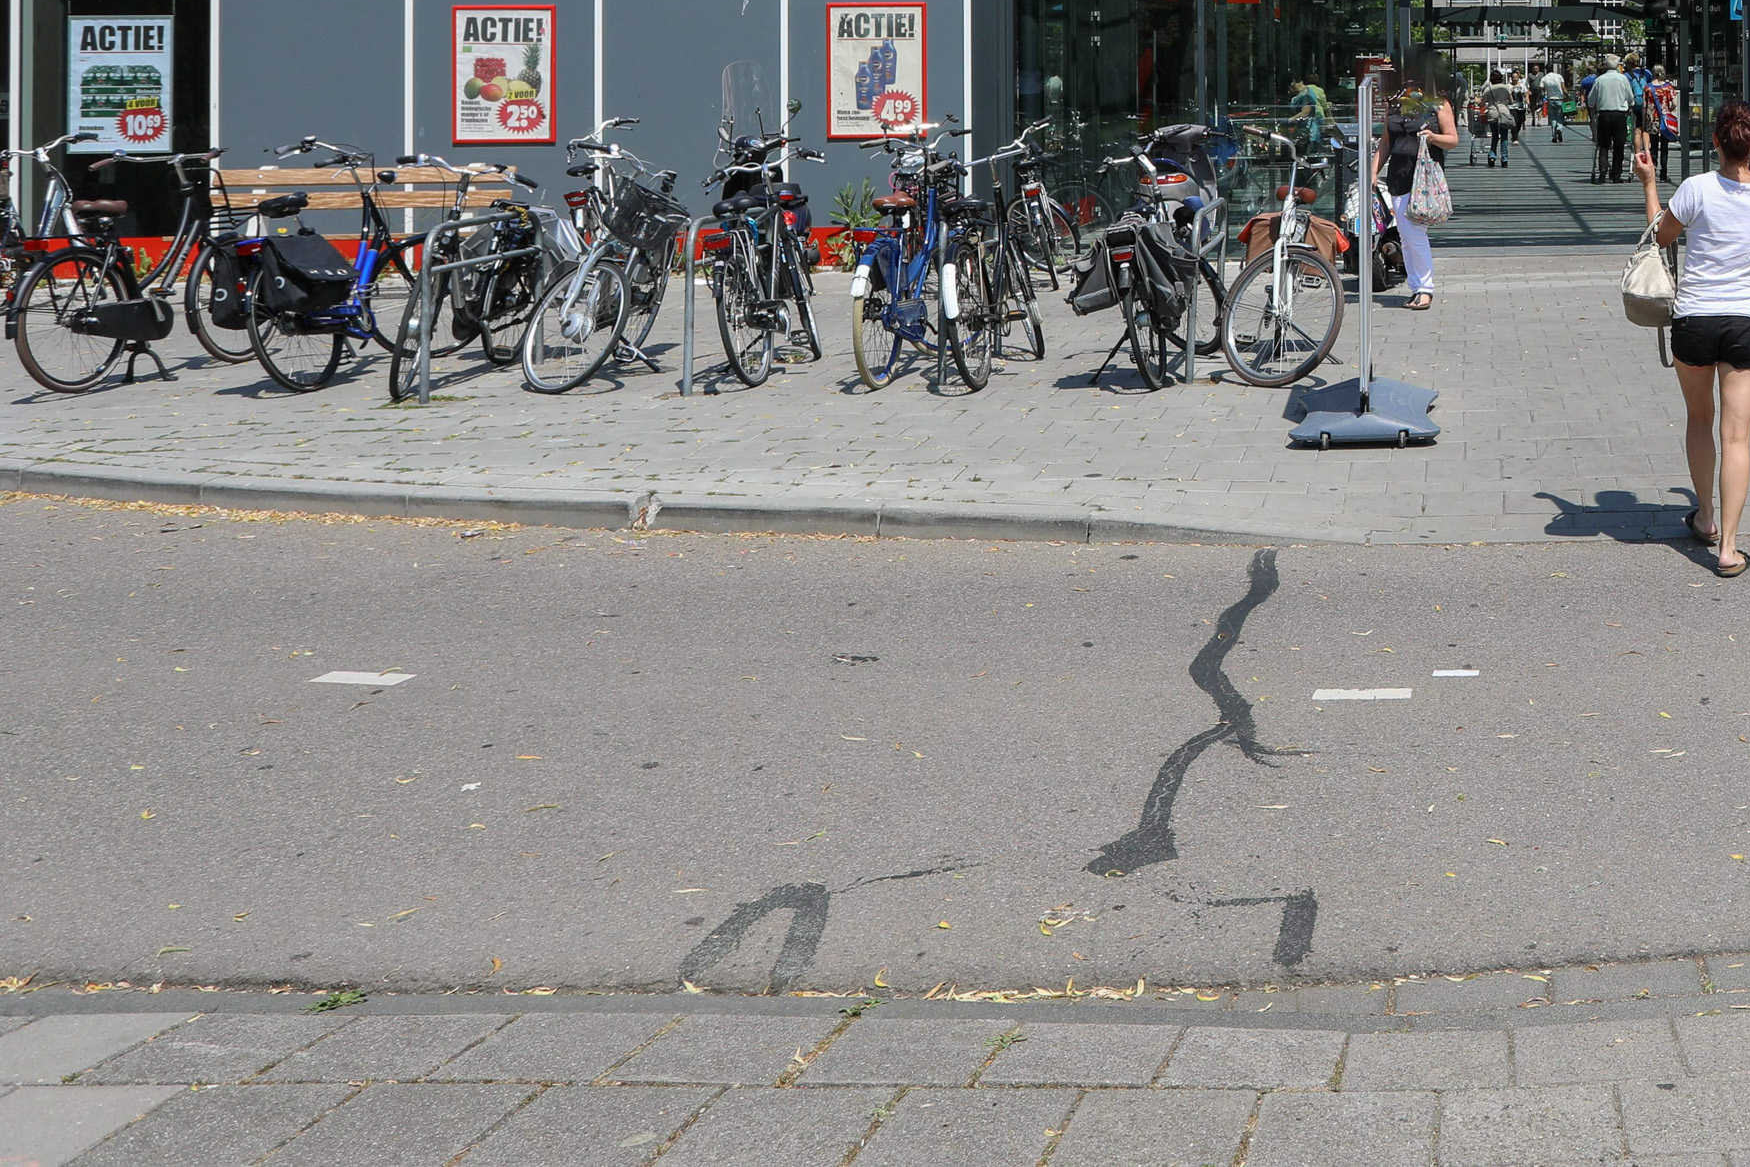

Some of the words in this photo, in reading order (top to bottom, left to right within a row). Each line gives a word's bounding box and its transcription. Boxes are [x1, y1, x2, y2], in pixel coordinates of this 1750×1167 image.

[80, 25, 164, 51] ACTIE!
[463, 17, 543, 42] ACTIE!
[838, 13, 915, 38] ACTIE!
[135, 98, 156, 108] VOOR
[514, 90, 534, 99] VOOR
